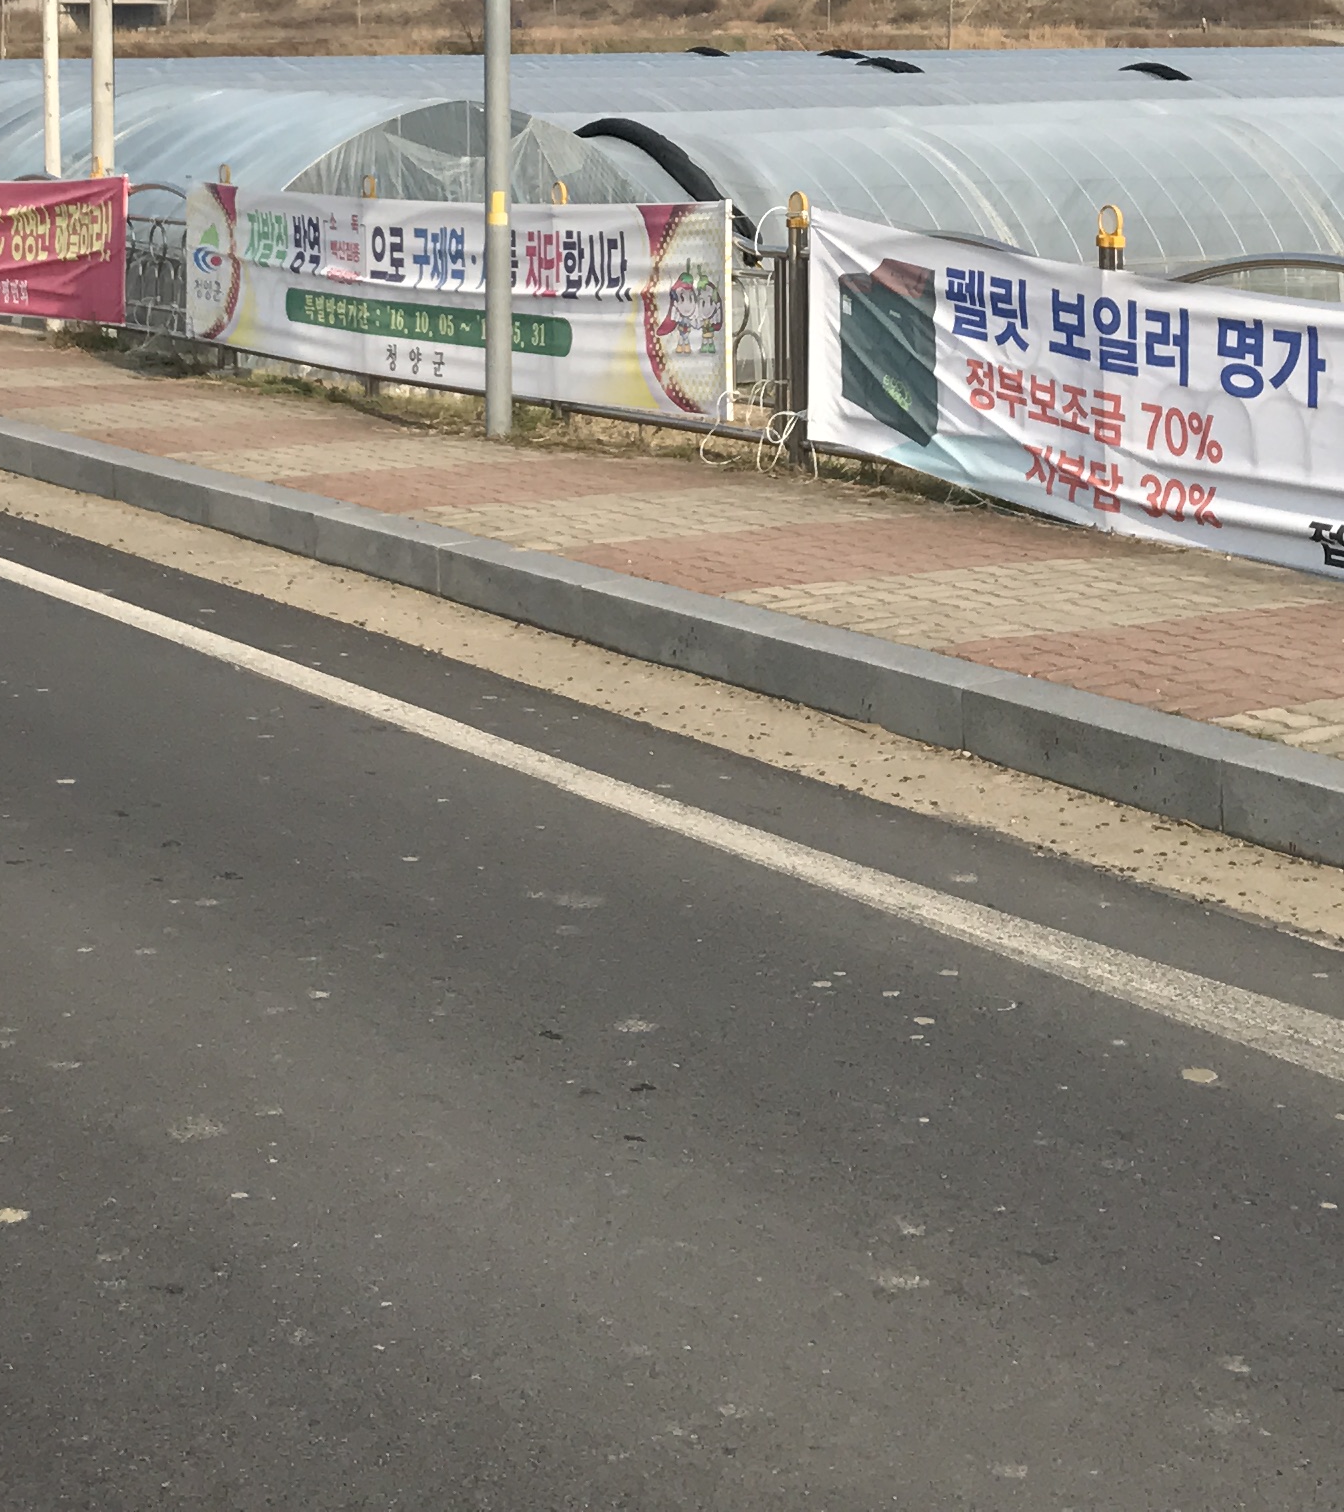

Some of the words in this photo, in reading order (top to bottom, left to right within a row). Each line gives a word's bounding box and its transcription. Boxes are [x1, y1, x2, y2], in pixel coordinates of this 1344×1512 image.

[289, 213, 322, 276] 방역
[370, 226, 406, 282] 으로
[944, 266, 1028, 353] 펠릿
[1048, 289, 1190, 386] 보일러
[1216, 317, 1326, 409] 명가
[965, 357, 1124, 448] 정부보조금
[1141, 401, 1224, 465] 70%
[1139, 474, 1223, 530] 30%
